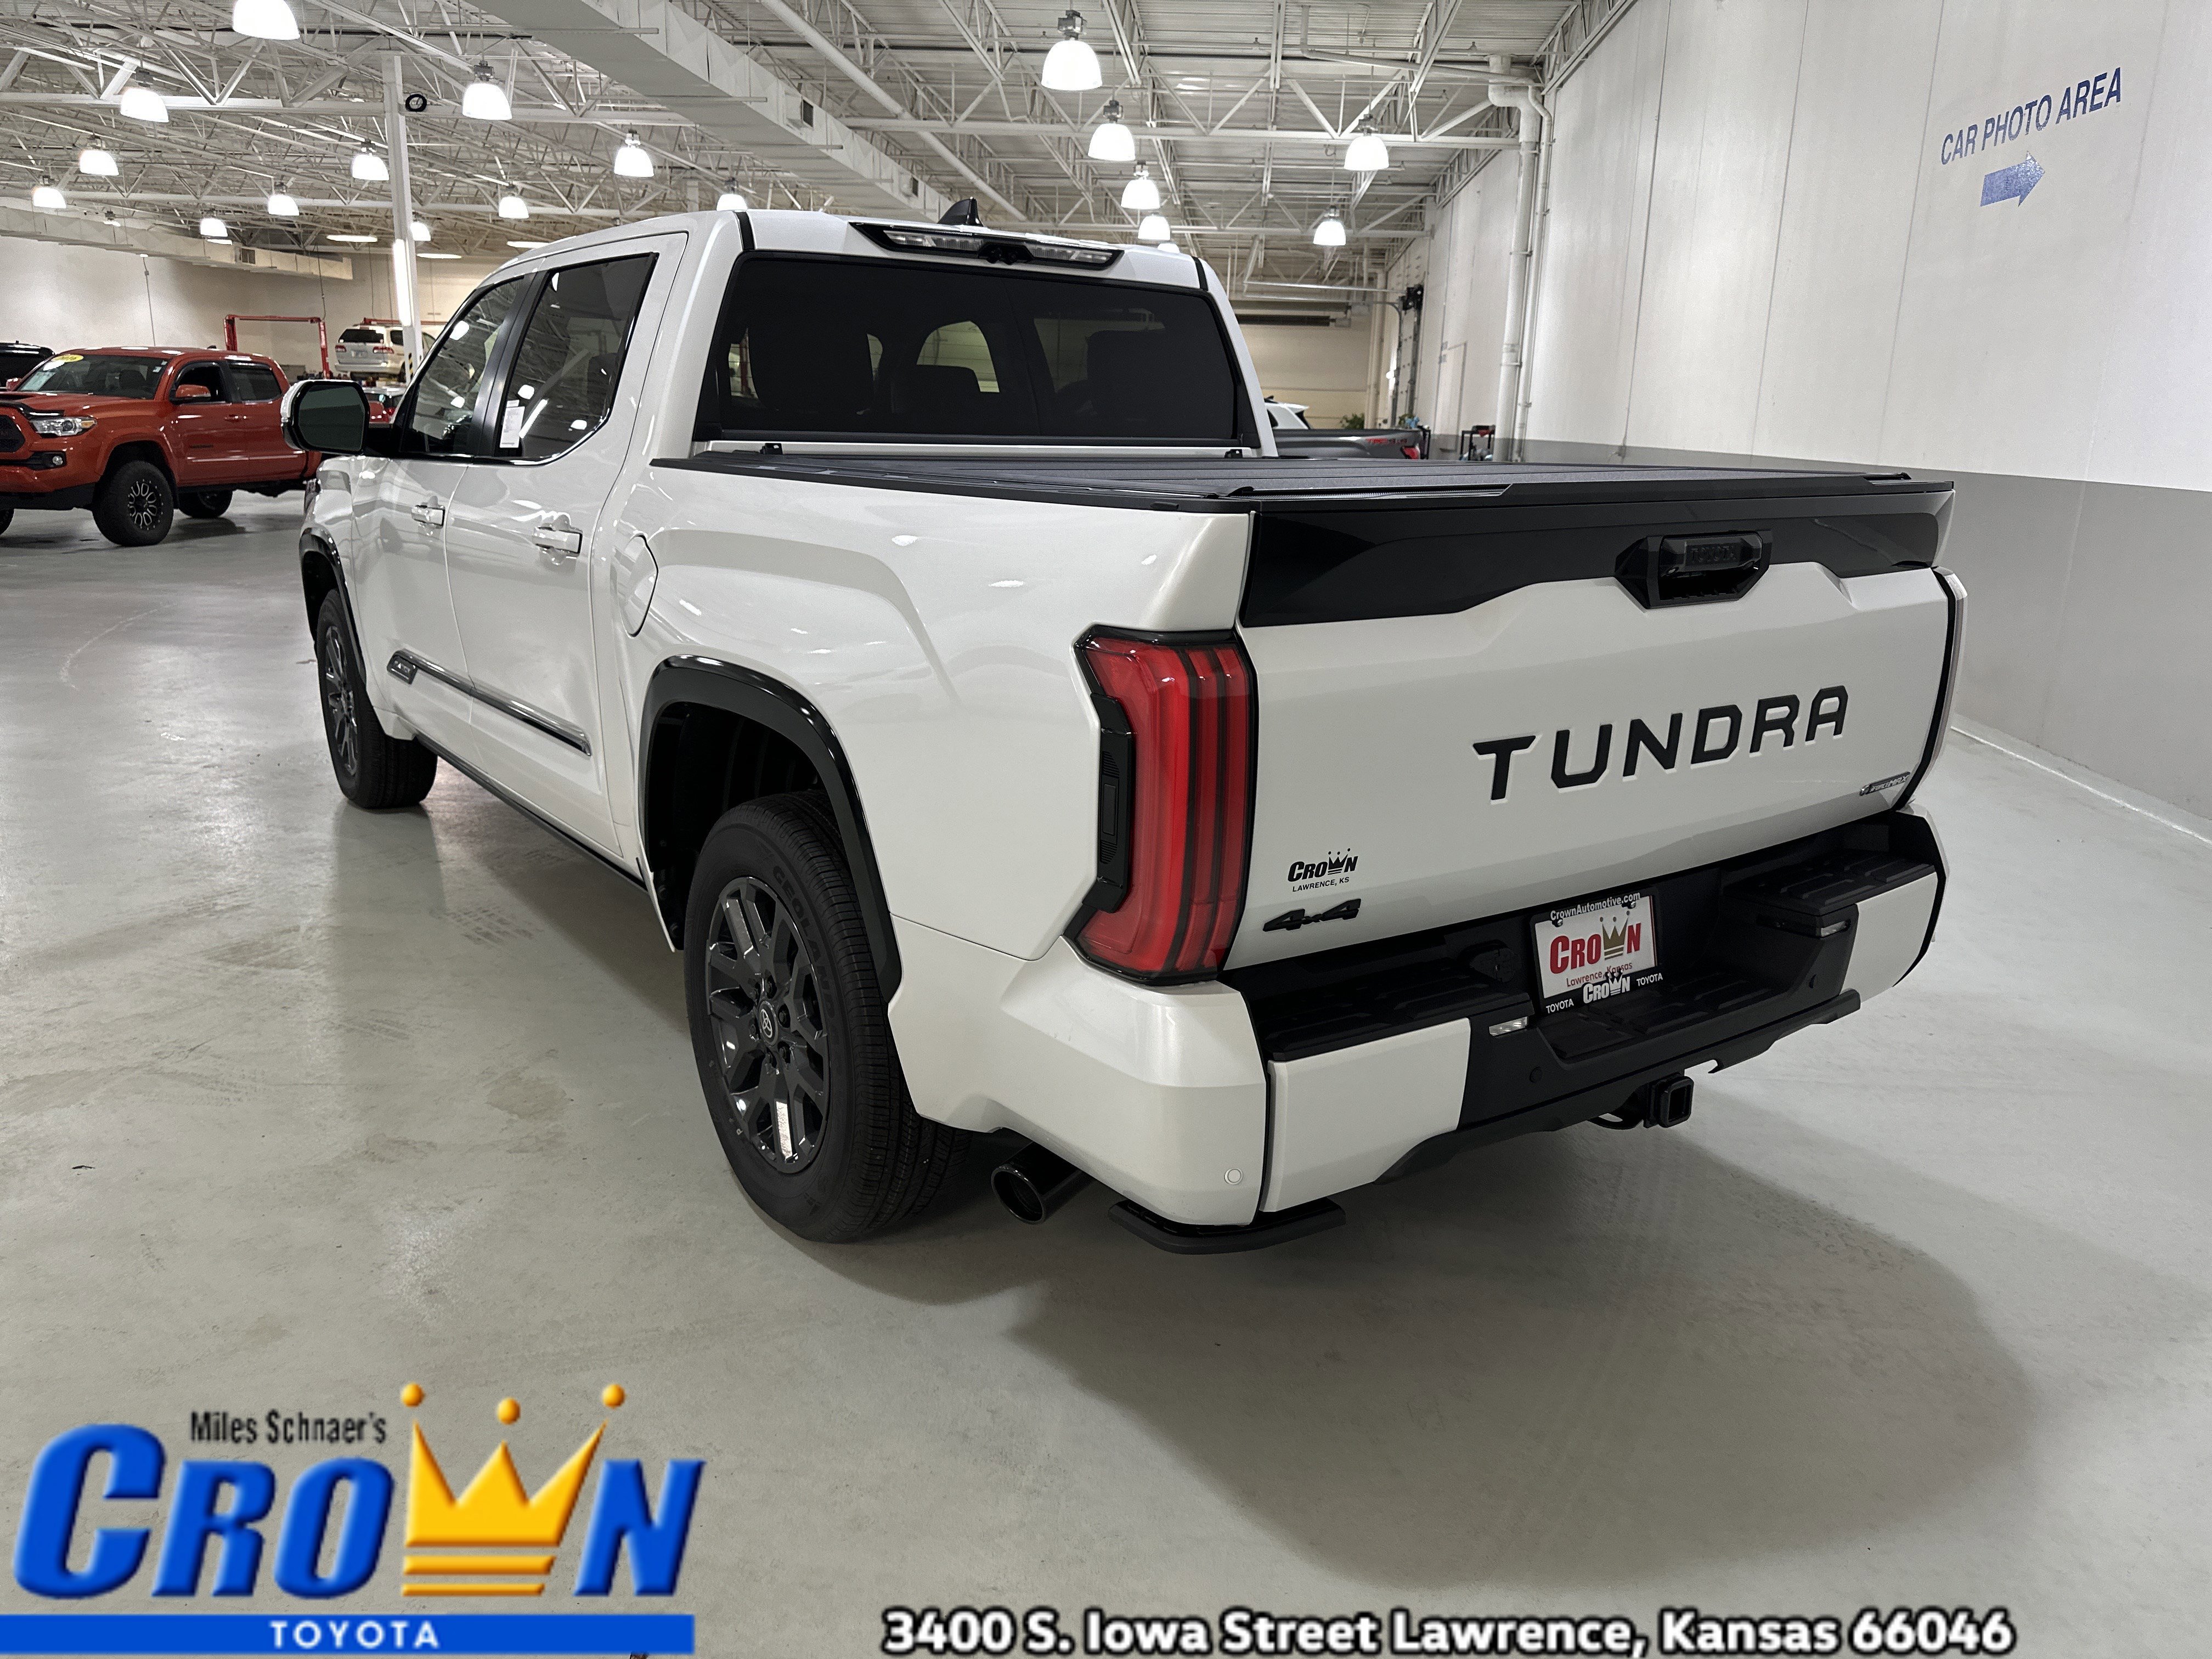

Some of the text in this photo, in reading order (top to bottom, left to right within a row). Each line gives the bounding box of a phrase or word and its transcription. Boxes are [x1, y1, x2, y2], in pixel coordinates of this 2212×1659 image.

[1941, 67, 2121, 165] CAR PHOTO AREA
[1472, 685, 1849, 803] TUNDRA
[1292, 879, 1338, 893] LAWRENCE,
[1550, 892, 1641, 921] CrownAutomotive.com
[1606, 962, 1633, 976] Kansas
[1545, 998, 1574, 1014] TOYOTA
[1637, 973, 1663, 986] TOYOTA
